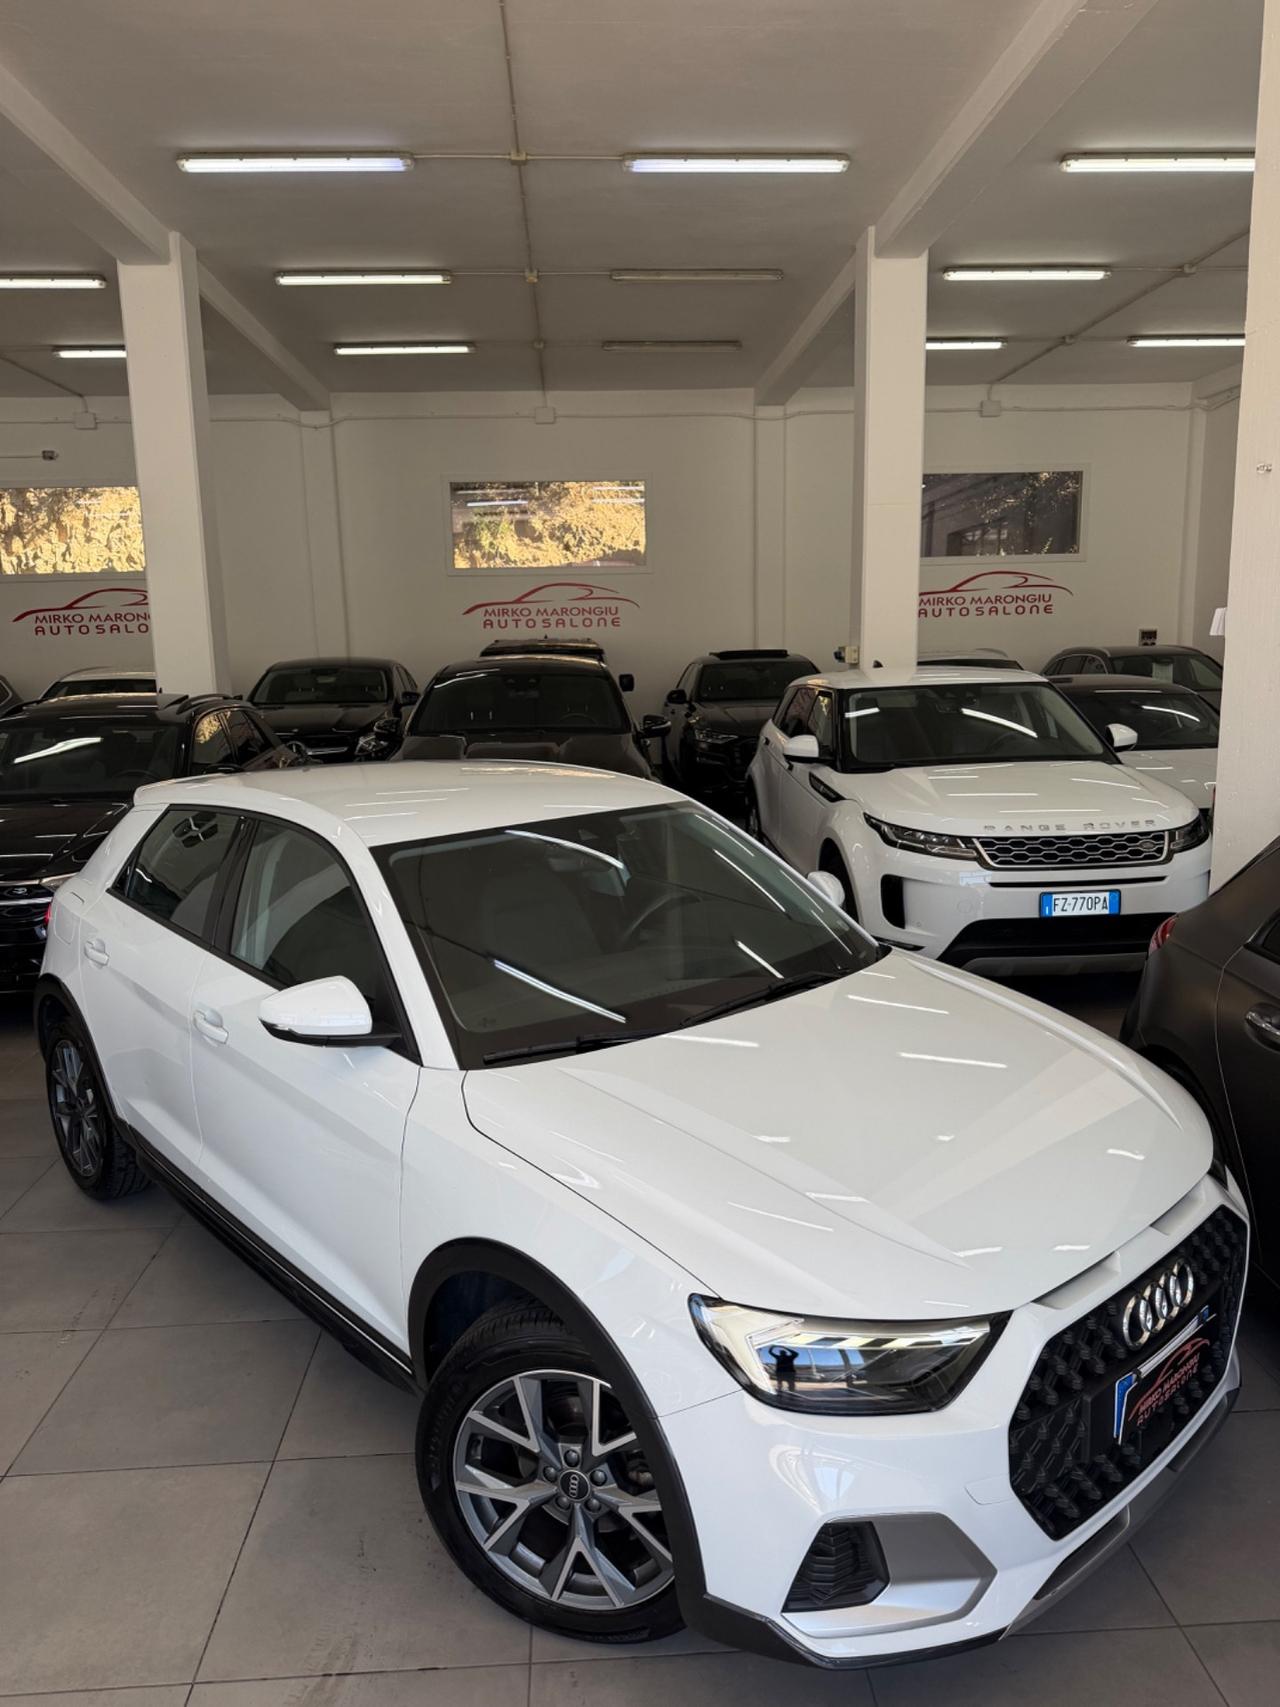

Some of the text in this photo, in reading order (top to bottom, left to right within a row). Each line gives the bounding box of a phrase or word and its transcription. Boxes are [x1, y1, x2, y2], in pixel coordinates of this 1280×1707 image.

[918, 594, 1052, 607] MIRKO MARONGIU
[483, 606, 619, 618] MIRKO MARONGIU
[918, 604, 1054, 618] AUTOSALONE
[35, 612, 150, 624] MIRKO MARON
[483, 617, 621, 629] AUTOSALONE
[984, 820, 1157, 832] RANGE ROVER
